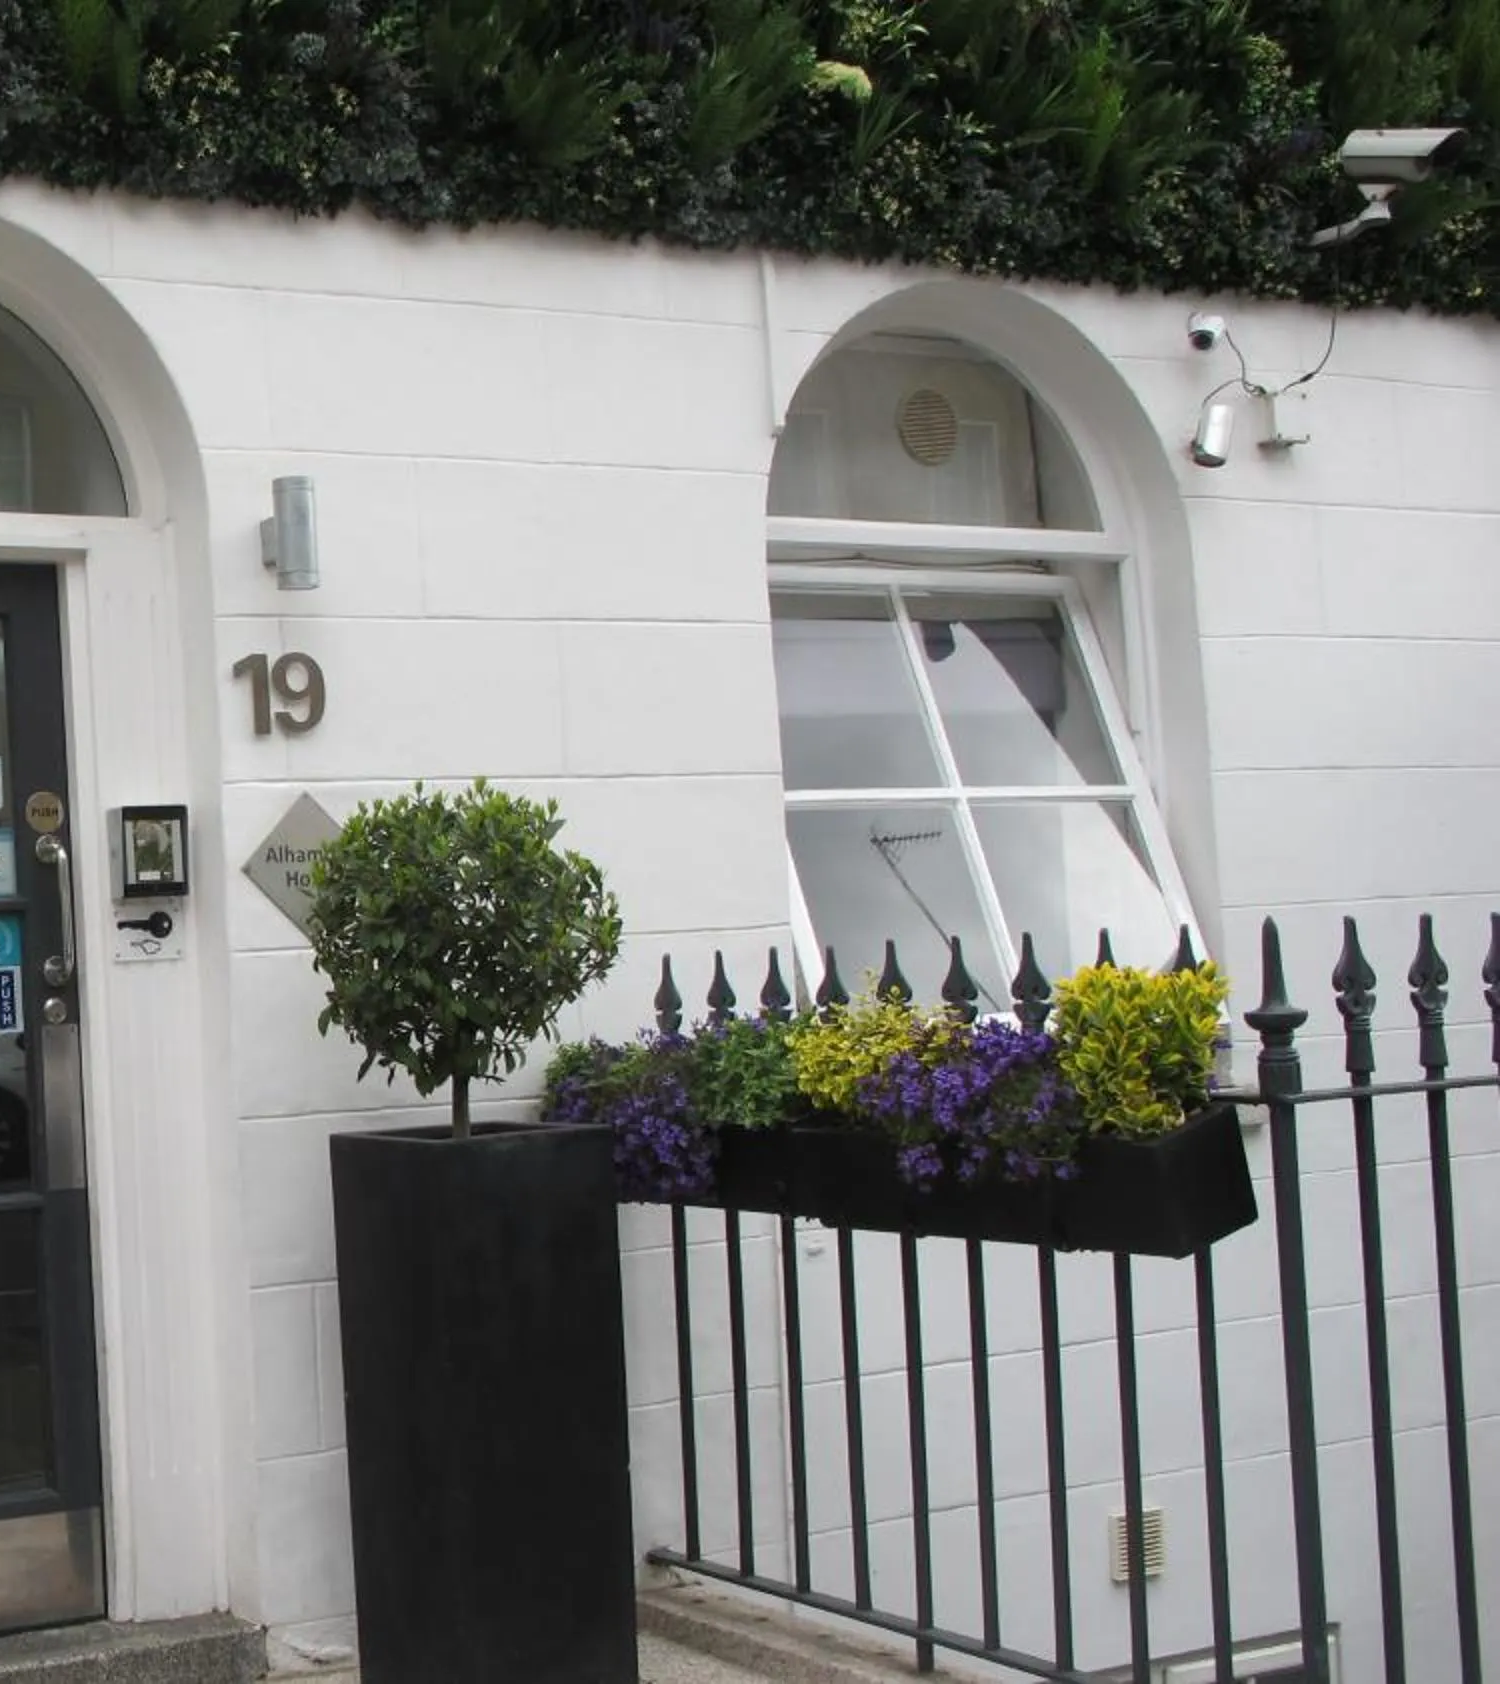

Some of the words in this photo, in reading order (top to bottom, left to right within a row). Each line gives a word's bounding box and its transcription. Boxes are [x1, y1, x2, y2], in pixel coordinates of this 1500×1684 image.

[233, 651, 326, 736] 19
[31, 806, 59, 818] PUSH
[265, 844, 325, 864] Alham
[1, 975, 14, 1026] PUSH
